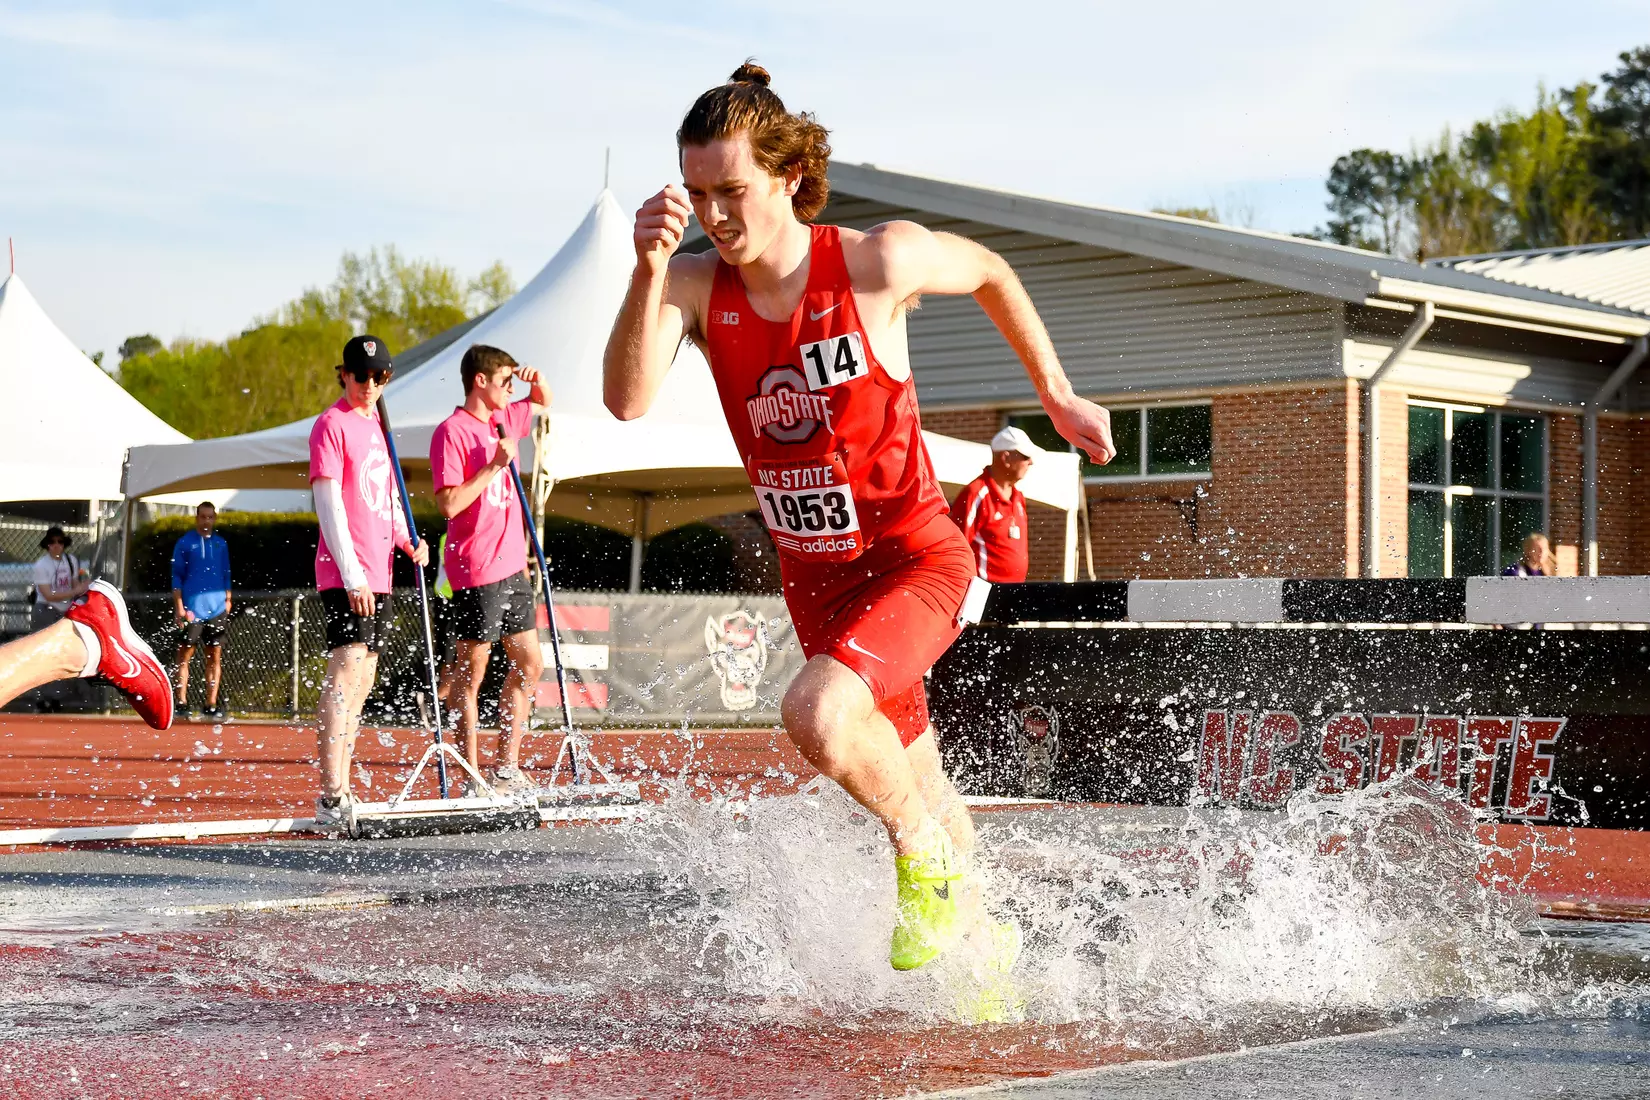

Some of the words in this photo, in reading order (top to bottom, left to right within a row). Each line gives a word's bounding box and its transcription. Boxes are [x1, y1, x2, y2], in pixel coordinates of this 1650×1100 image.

[805, 336, 858, 386] 14
[746, 395, 780, 439] OHIO
[777, 387, 835, 436] STATE
[758, 469, 779, 487] NC
[781, 465, 834, 488] STATE
[763, 491, 850, 532] 1953
[802, 537, 857, 553] adidas
[1197, 708, 1301, 804] NC
[1314, 711, 1569, 821] STATE
